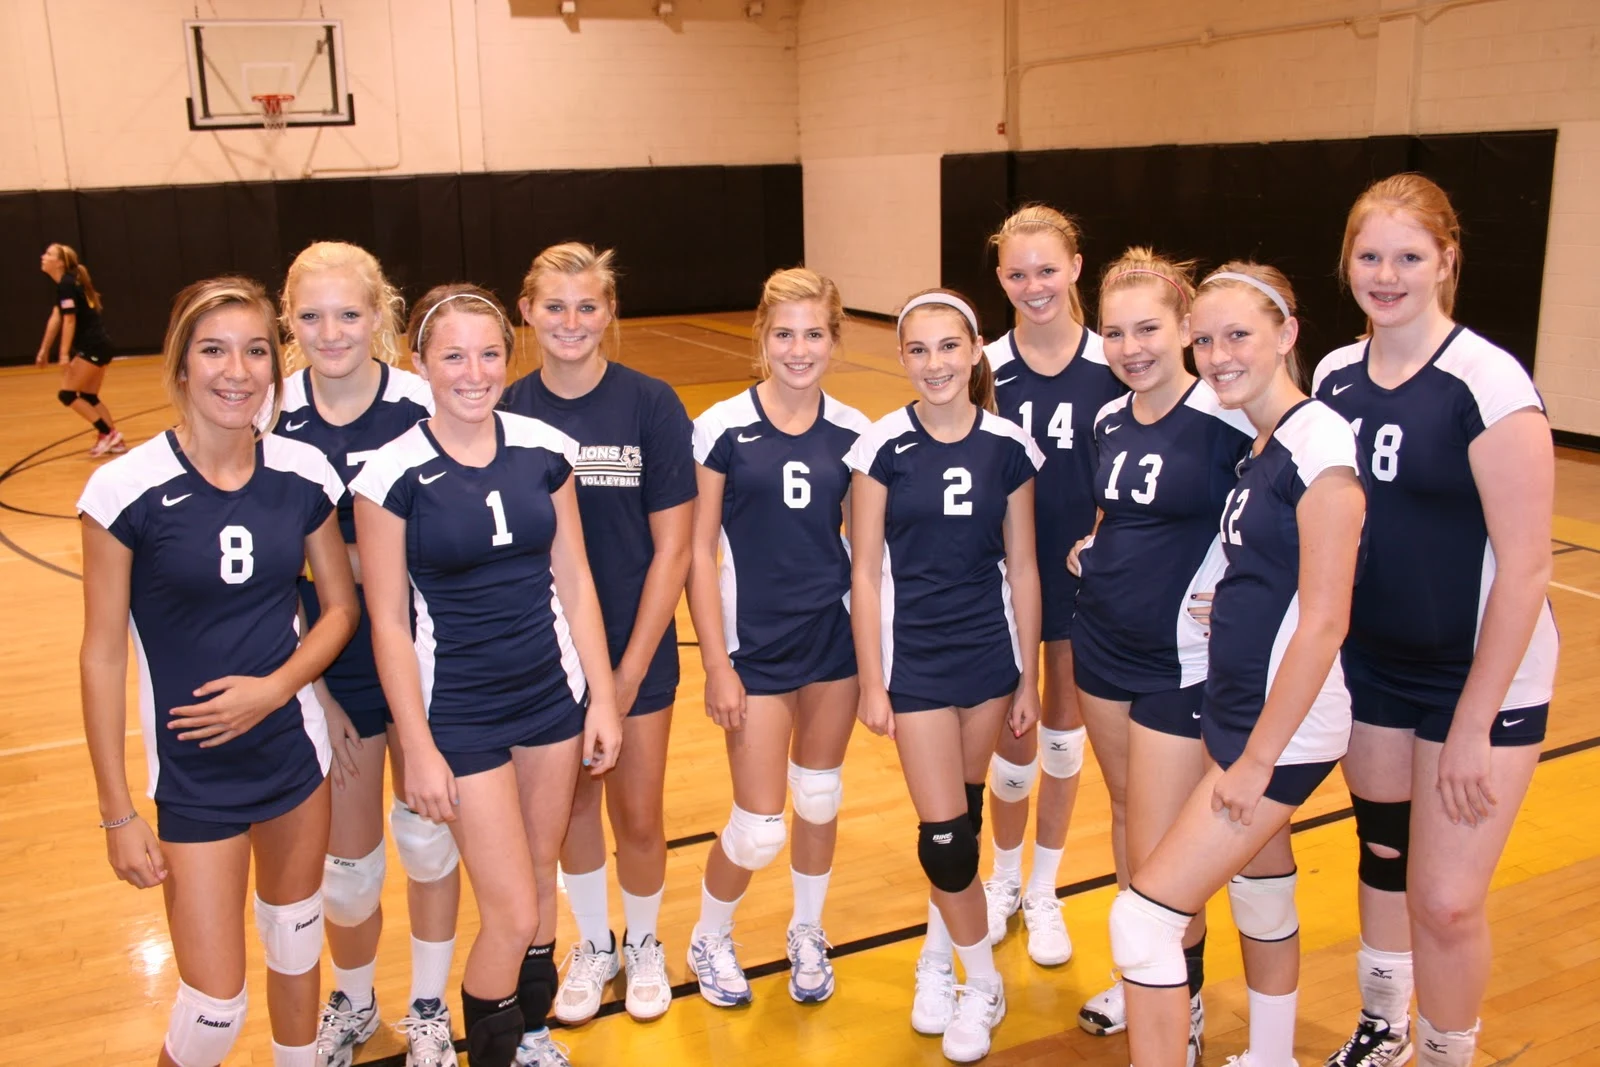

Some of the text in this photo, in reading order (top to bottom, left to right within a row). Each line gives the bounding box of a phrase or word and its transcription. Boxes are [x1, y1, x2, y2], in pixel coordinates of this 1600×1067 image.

[1019, 401, 1074, 449] 14
[580, 475, 640, 487] VOLLEYBALL
[783, 461, 811, 509] 6
[942, 467, 973, 515] 2
[1104, 450, 1163, 505] 13
[485, 490, 513, 546] 1
[1219, 488, 1250, 546] 12
[219, 525, 254, 584] 8
